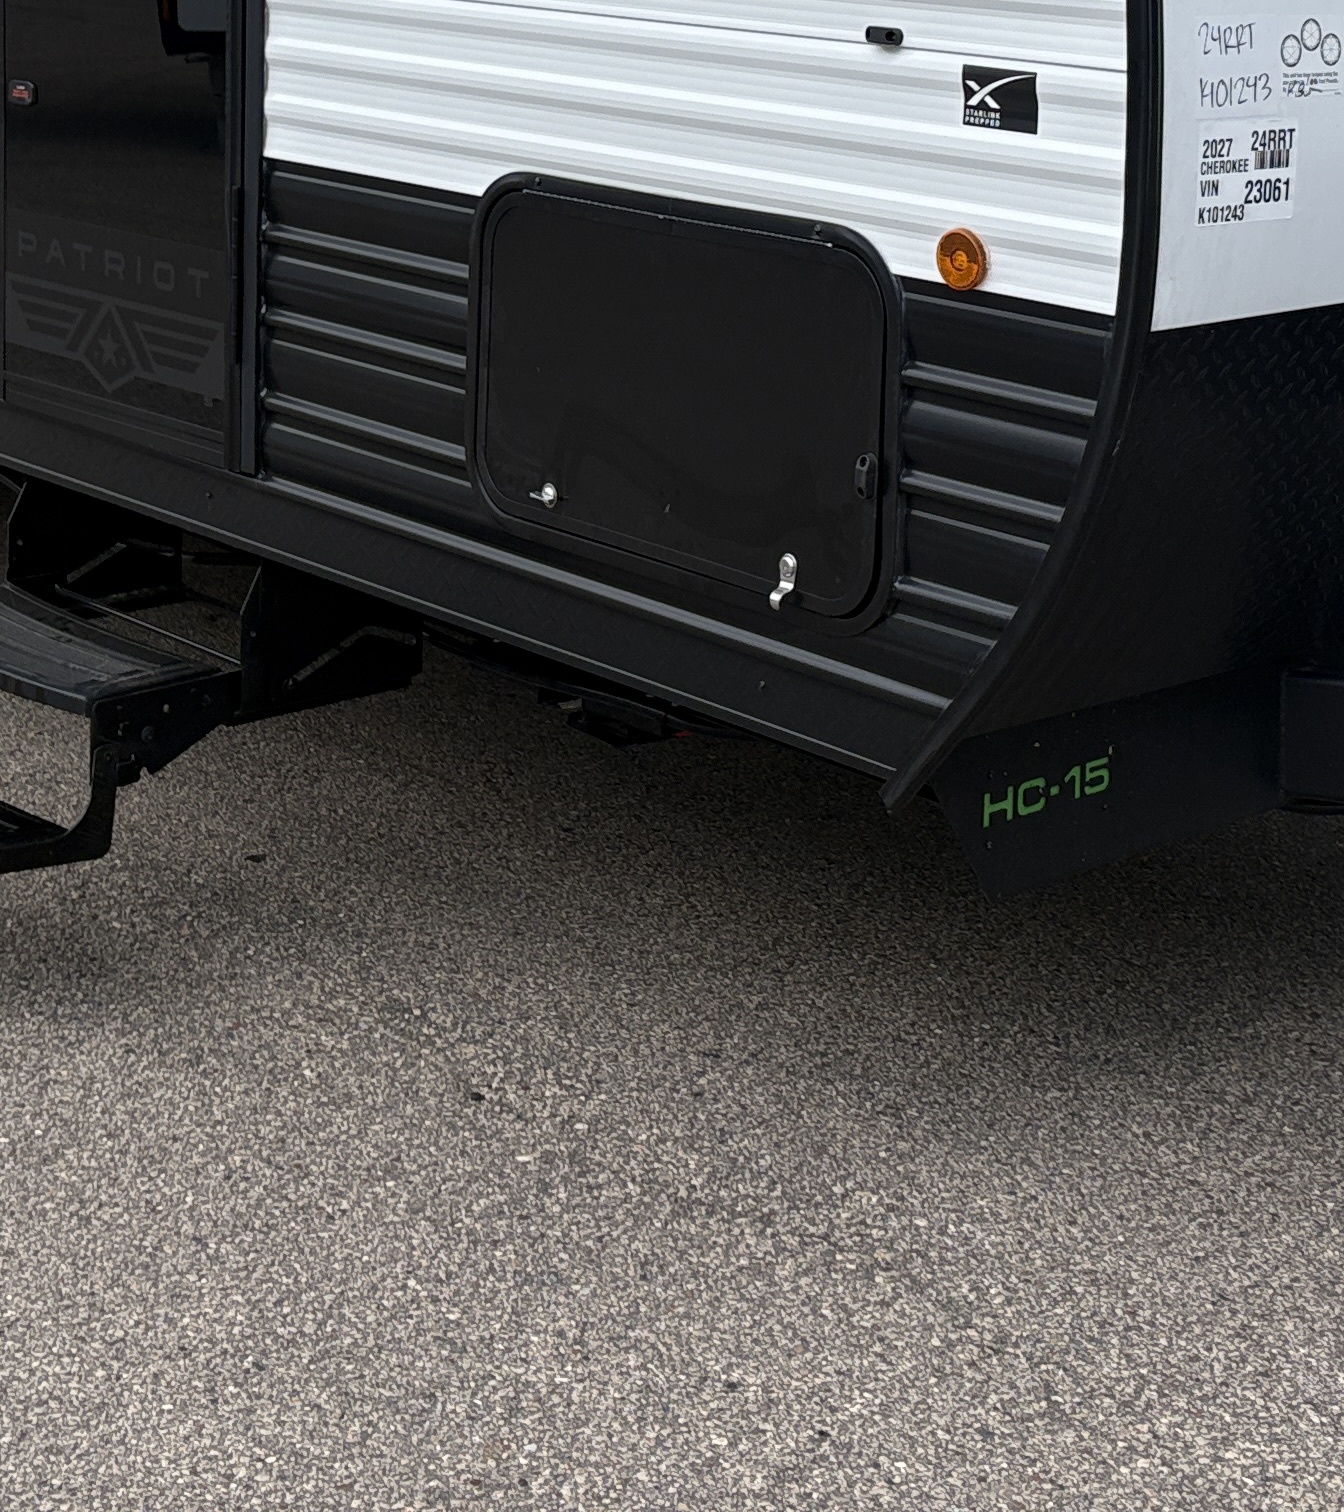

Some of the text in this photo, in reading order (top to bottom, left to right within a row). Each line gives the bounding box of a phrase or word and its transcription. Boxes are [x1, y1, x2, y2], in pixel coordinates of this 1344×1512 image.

[965, 108, 1001, 119] STARLINK
[965, 116, 1001, 127] PREPPED
[1202, 128, 1296, 159] 2027 24RRT
[1200, 158, 1249, 176] CHEROKEE
[1200, 177, 1291, 204] VIN 23061
[1197, 203, 1245, 225] K101243
[17, 229, 210, 300] PATRIOT
